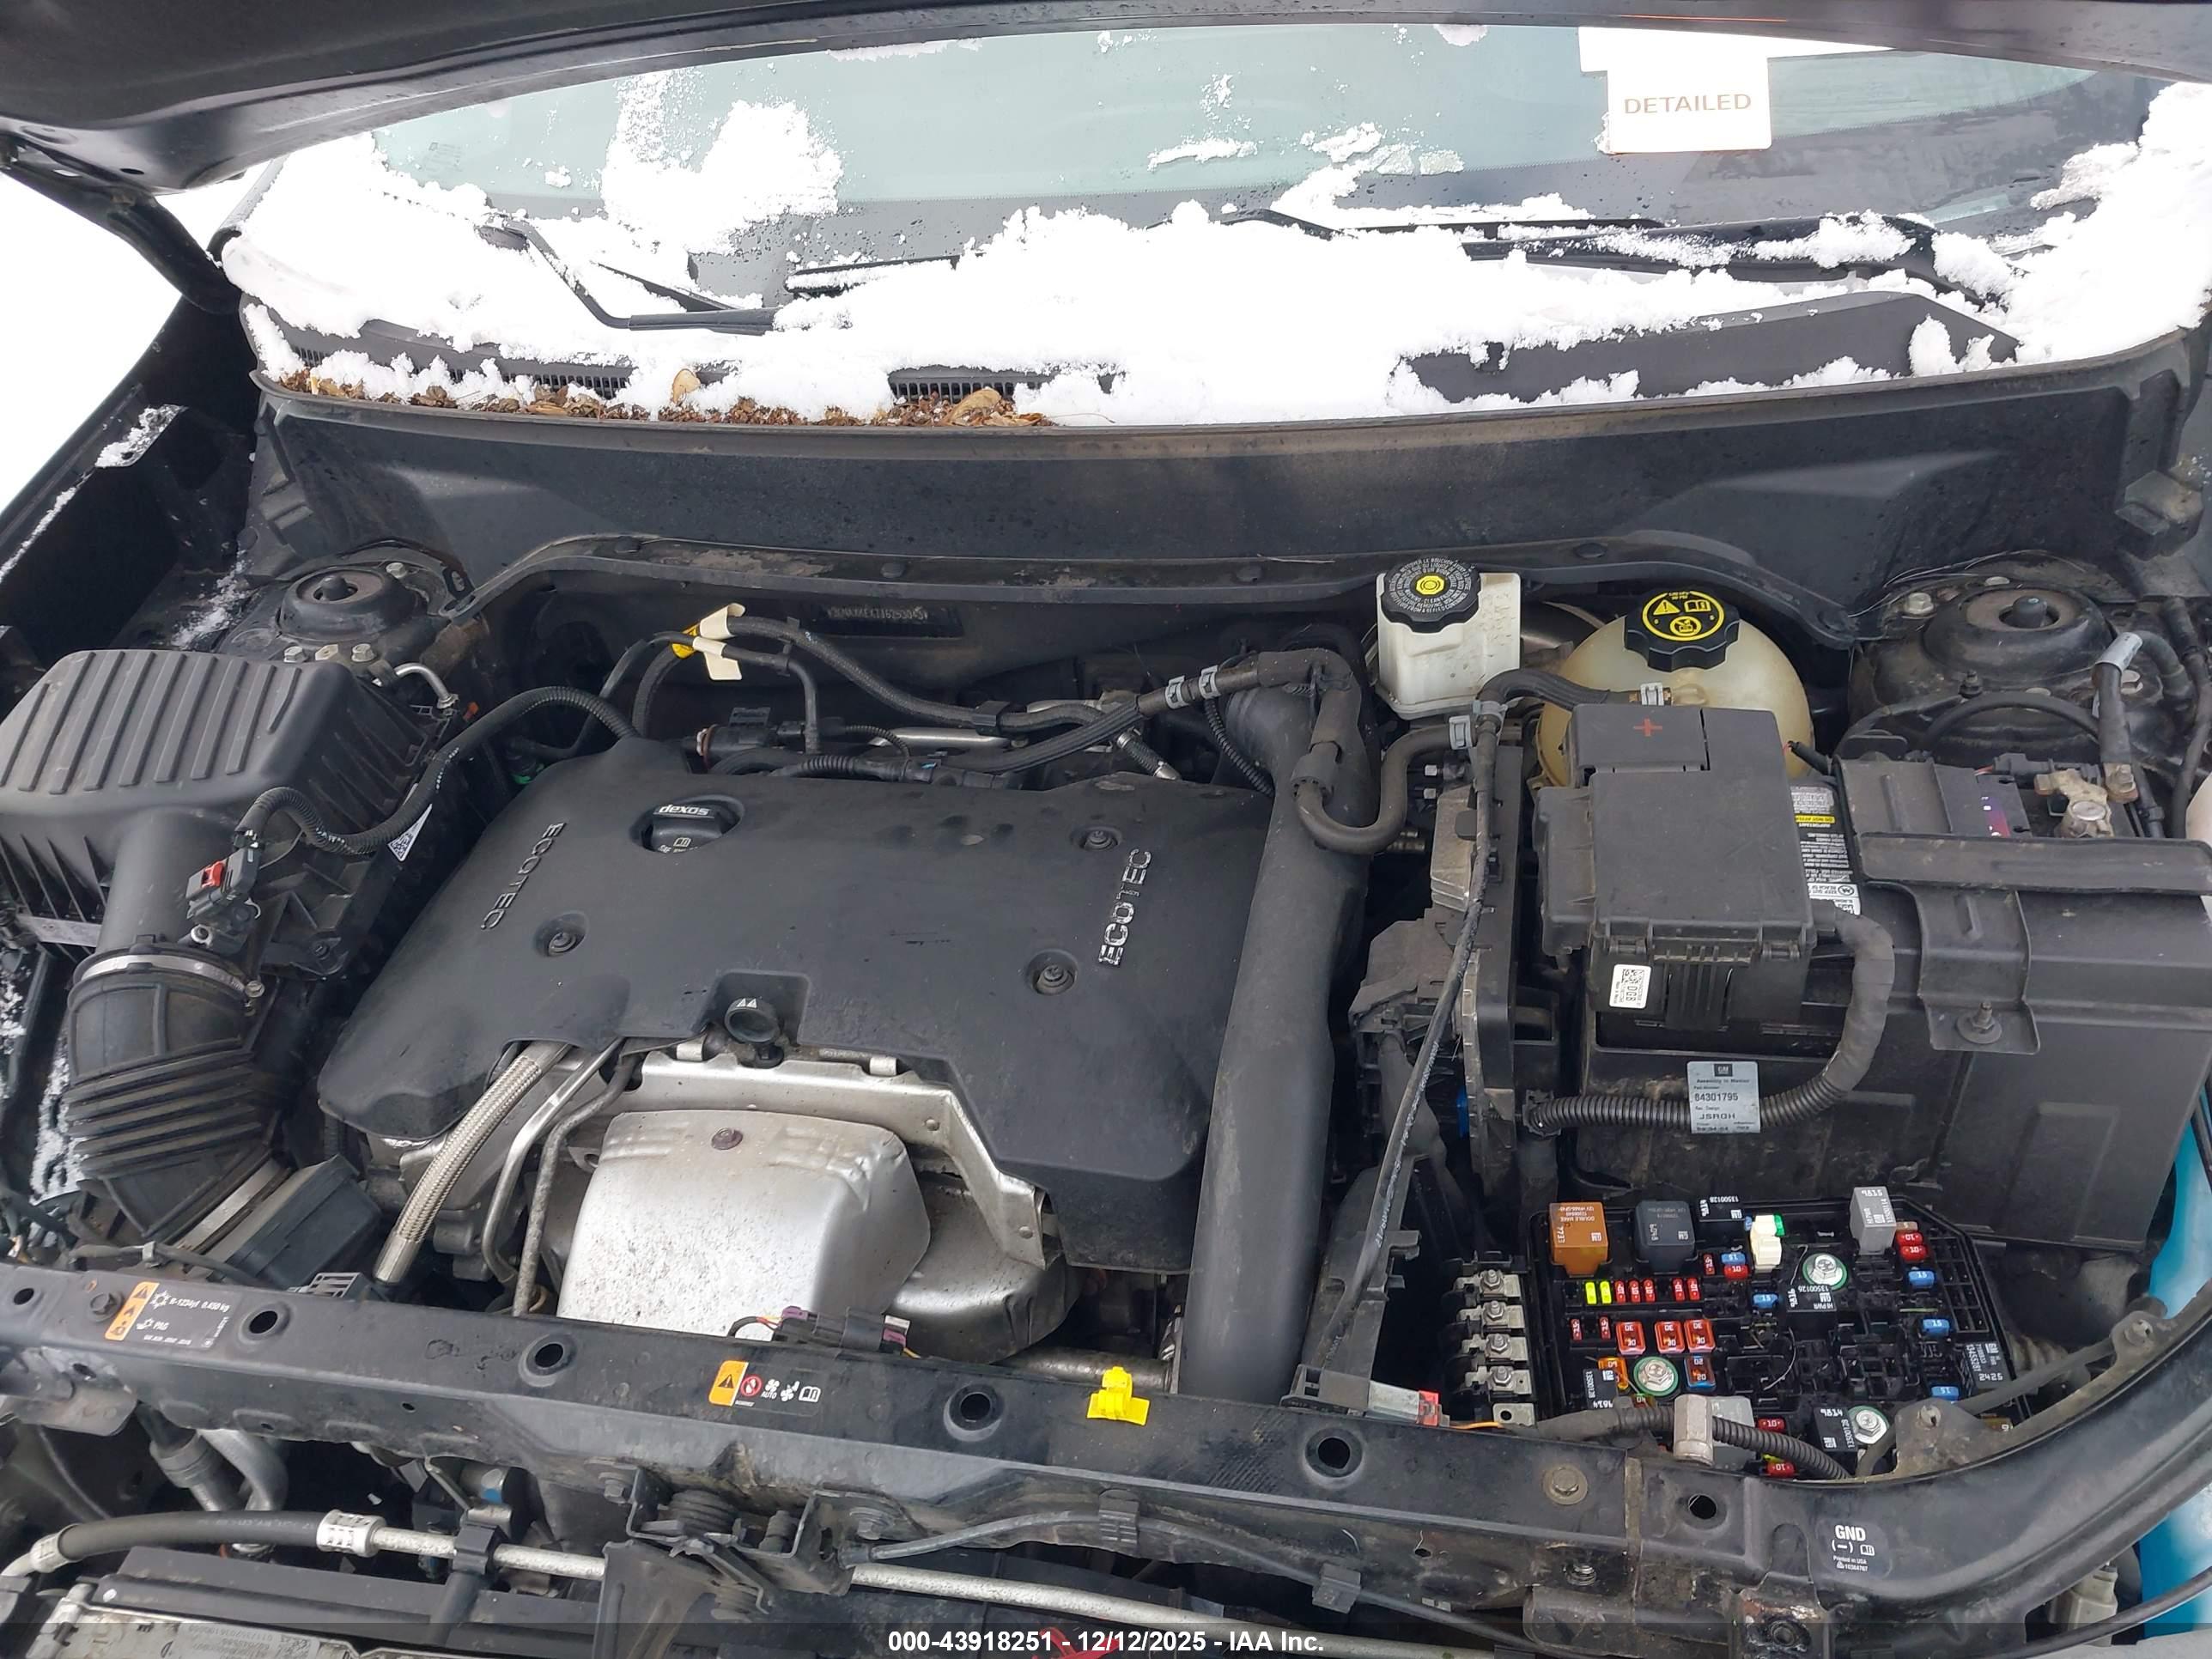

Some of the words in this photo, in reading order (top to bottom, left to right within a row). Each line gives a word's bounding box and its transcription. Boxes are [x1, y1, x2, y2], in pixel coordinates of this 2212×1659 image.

[1624, 94, 1752, 114] DETAILED
[659, 805, 710, 816] dexos
[481, 822, 567, 929] ECOTEC
[1098, 848, 1152, 965] ECOTEC
[761, 1391, 777, 1400] AUTO
[1835, 1525, 1866, 1541] GND
